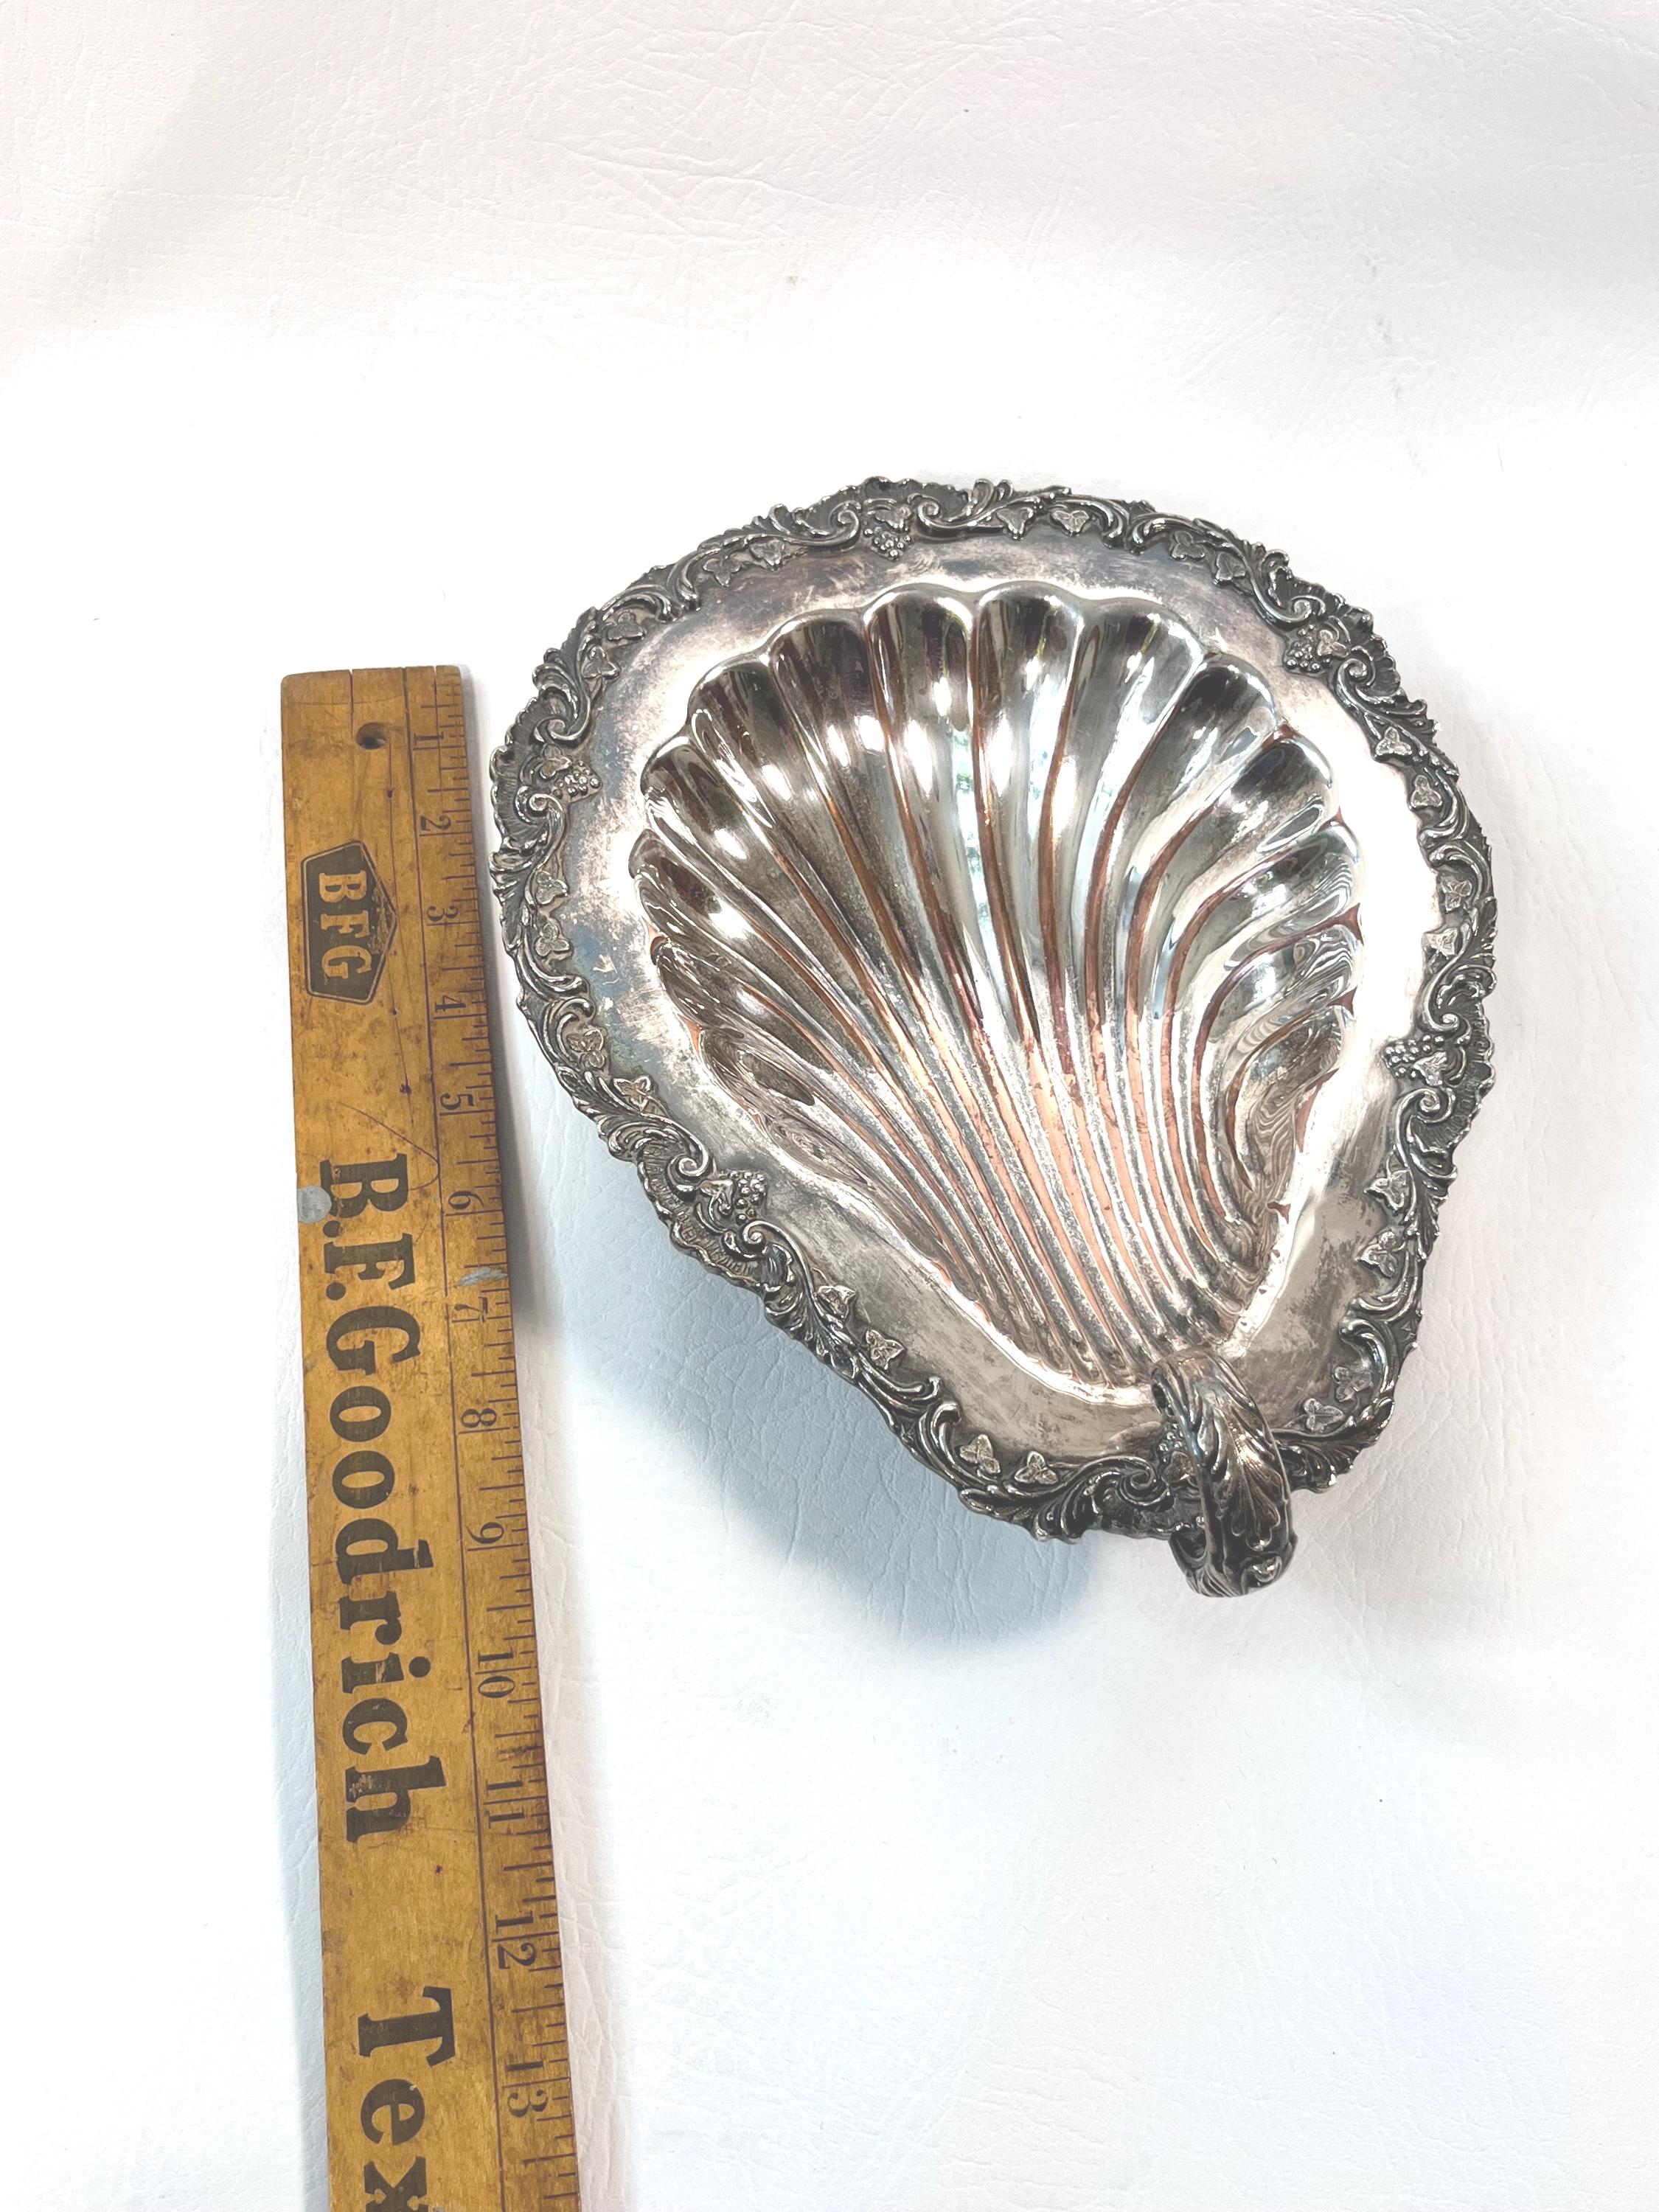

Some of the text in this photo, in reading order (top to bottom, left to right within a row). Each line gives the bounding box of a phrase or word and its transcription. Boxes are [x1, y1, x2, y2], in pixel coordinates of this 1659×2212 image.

[413, 732, 445, 746] 1
[420, 813, 452, 833] 2
[426, 904, 459, 923] 3
[319, 871, 372, 981] BFG
[433, 995, 467, 1015] 4
[439, 1092, 476, 1111] 5
[447, 1189, 485, 1210] 6
[452, 1295, 489, 1323] 7
[460, 1407, 498, 1428] 8
[466, 1521, 505, 1545] 9
[476, 1646, 516, 1700] 10
[485, 1778, 525, 1829] 11
[495, 1910, 538, 1970] 12
[358, 1985, 456, 2211] Tex
[505, 2060, 549, 2118] 13
